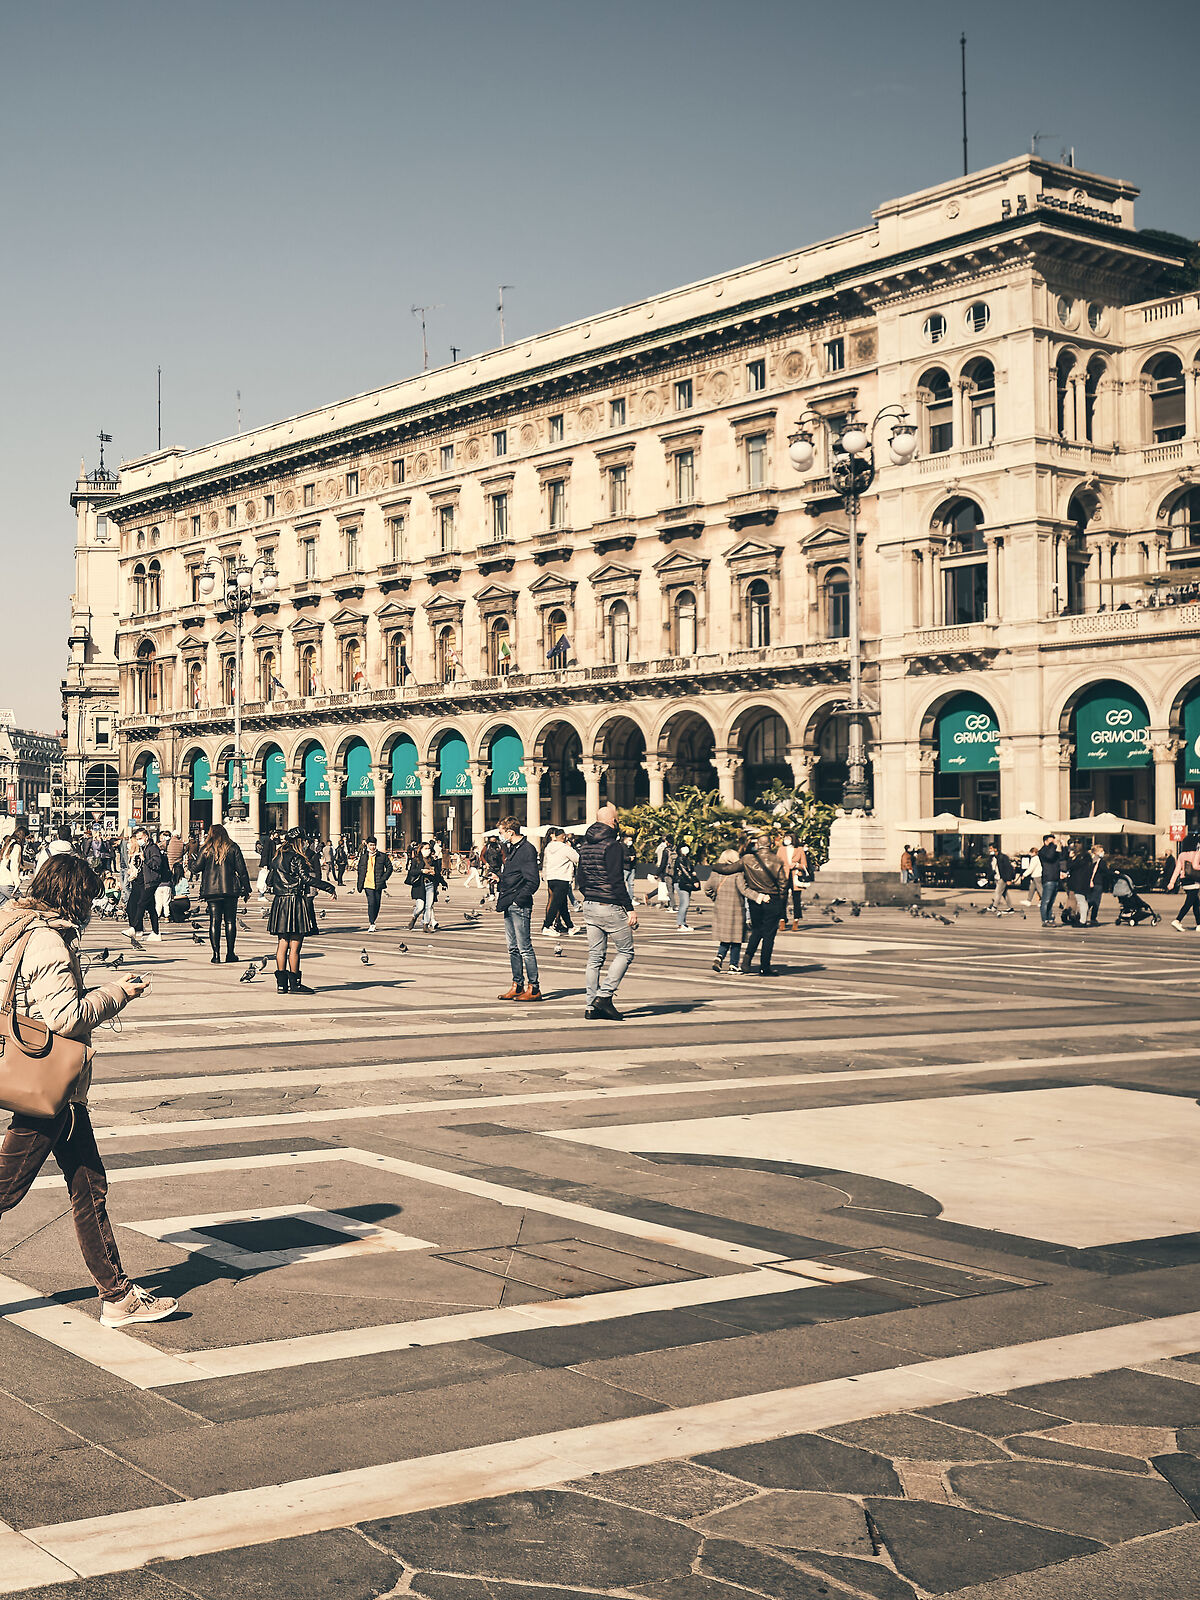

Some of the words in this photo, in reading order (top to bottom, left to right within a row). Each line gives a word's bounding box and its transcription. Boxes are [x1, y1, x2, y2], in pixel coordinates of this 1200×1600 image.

[953, 731, 1000, 744] GRIMOLD
[1091, 729, 1150, 744] GRIMOLDI
[1182, 793, 1193, 806] M
